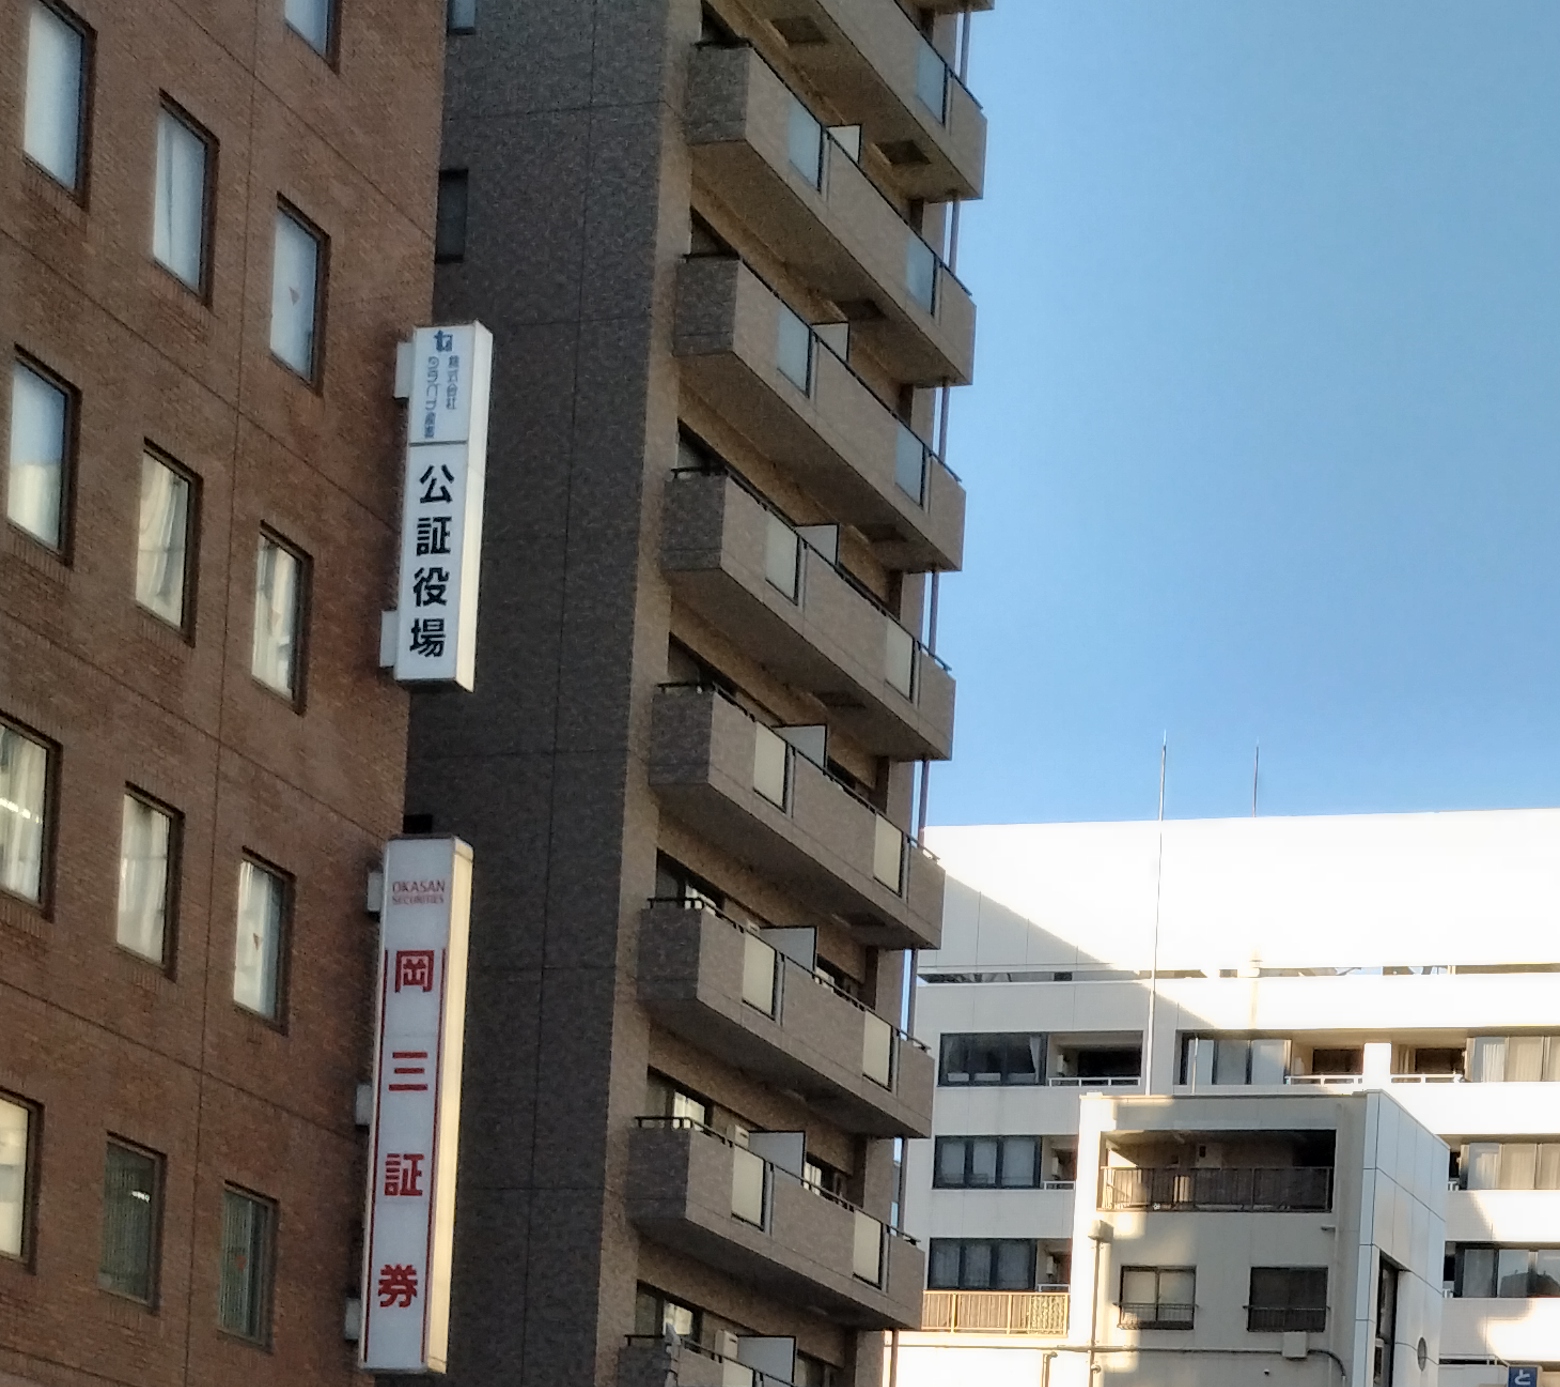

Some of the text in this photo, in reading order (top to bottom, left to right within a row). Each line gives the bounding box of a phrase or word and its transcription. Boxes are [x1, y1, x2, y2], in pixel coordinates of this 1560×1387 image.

[409, 463, 455, 658] 公証役場
[392, 881, 445, 892] OKASAN
[377, 949, 435, 1308] 岡三証券
